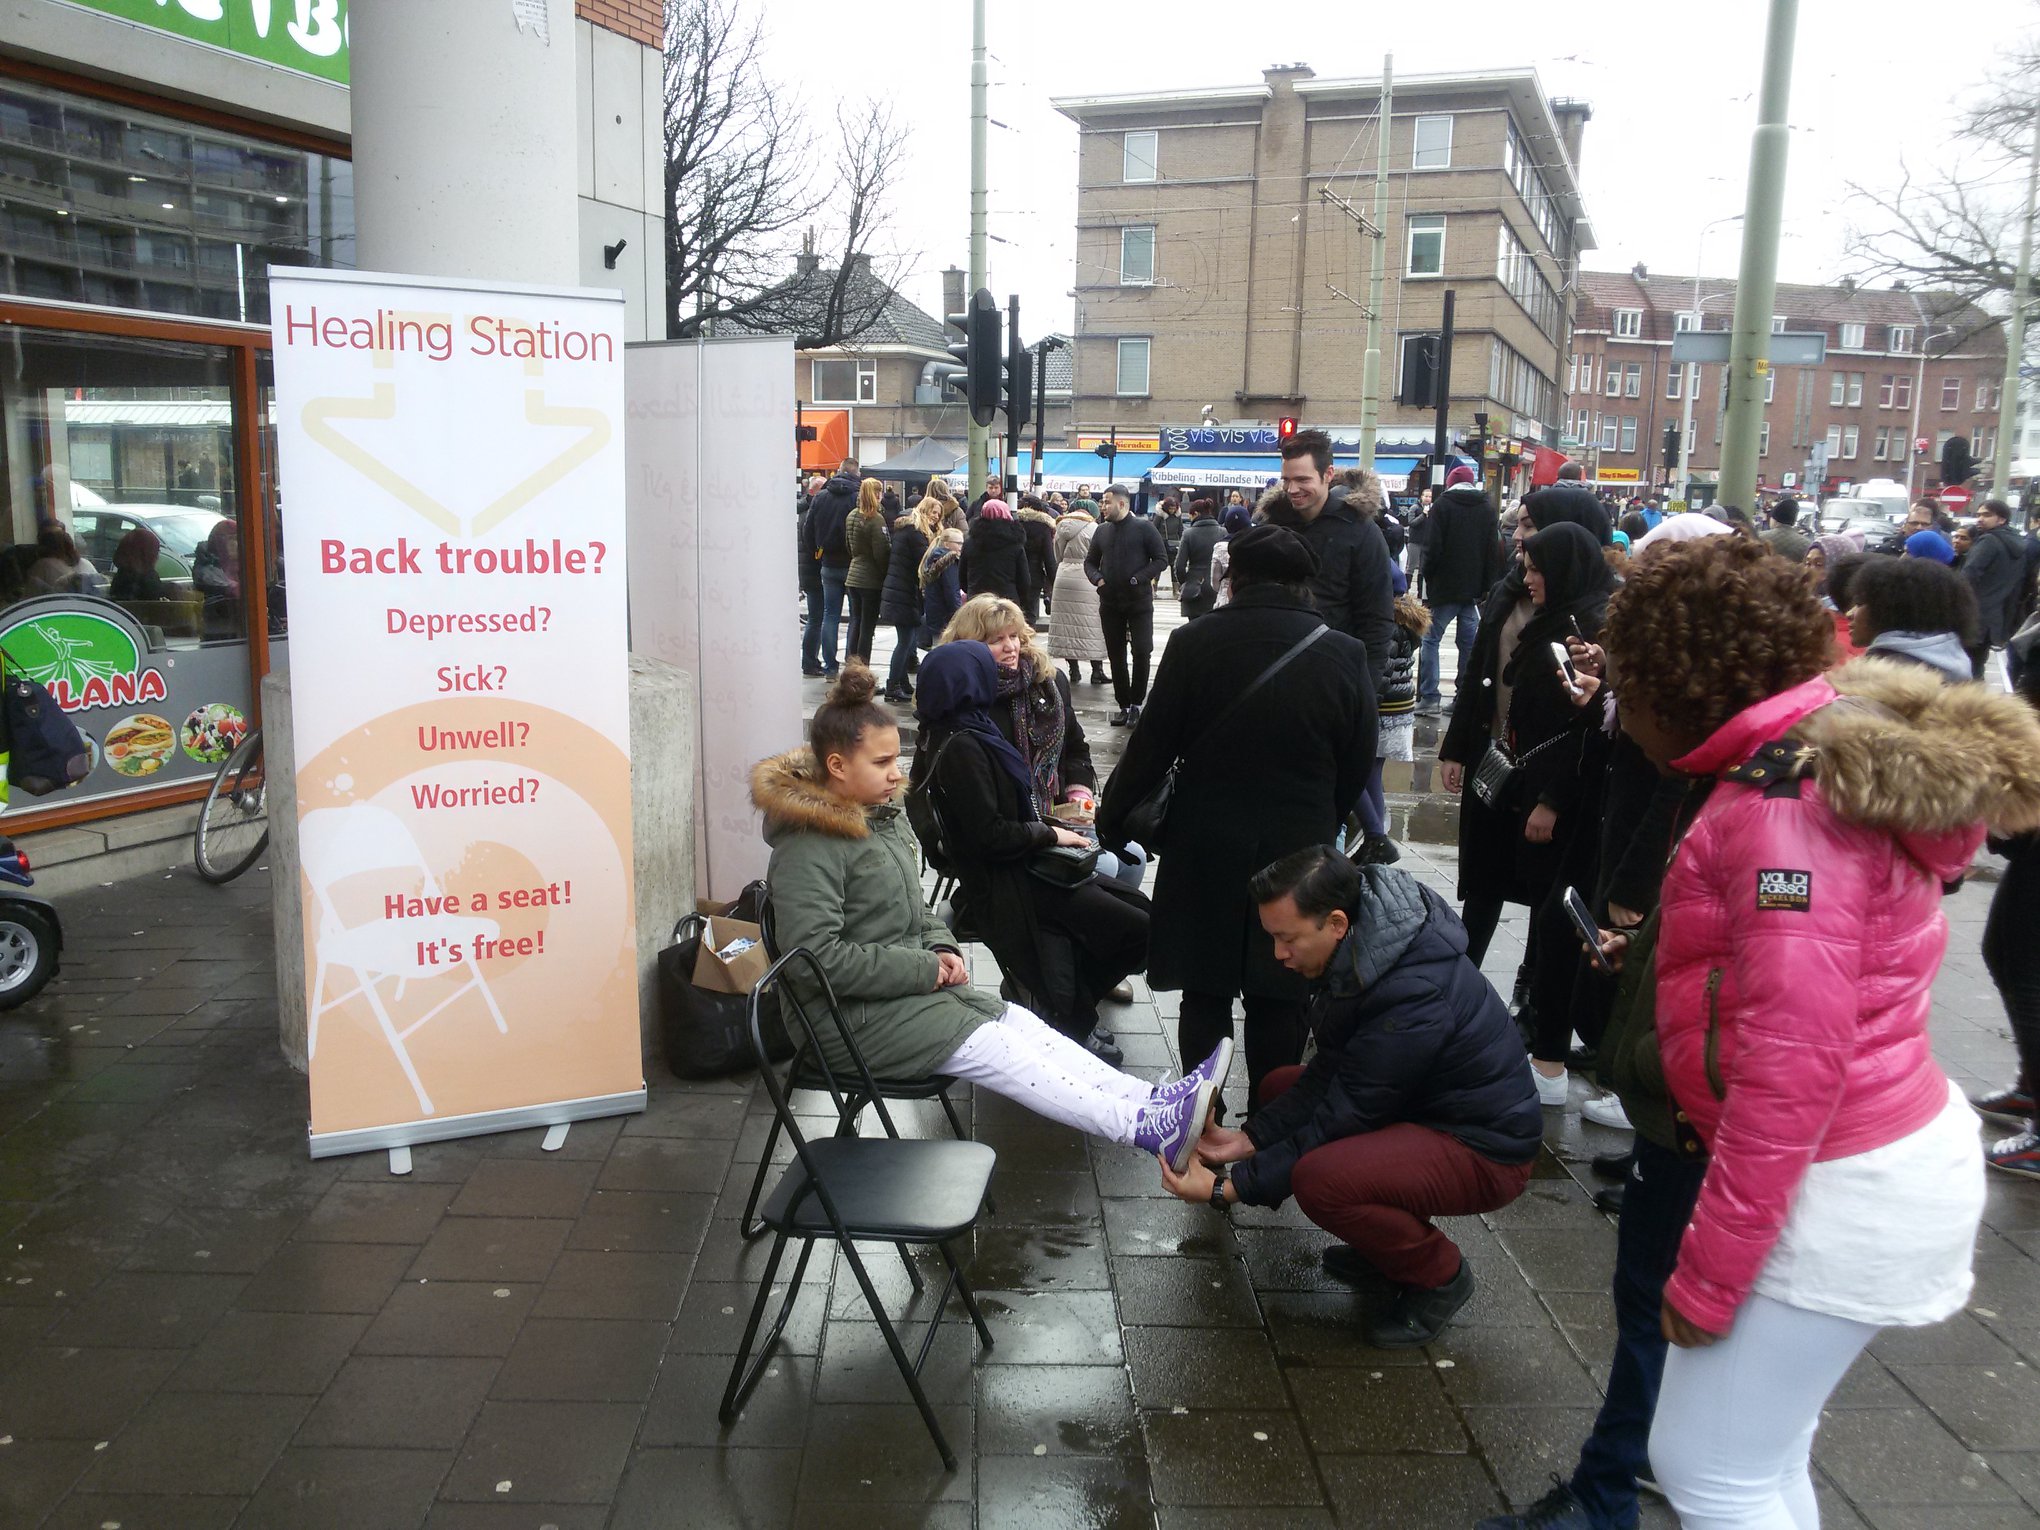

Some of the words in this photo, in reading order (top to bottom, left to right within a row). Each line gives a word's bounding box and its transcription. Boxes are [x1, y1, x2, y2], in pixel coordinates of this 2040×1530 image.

[286, 305, 452, 361] Healing
[470, 315, 613, 362] Station
[1190, 430, 1215, 443] VIS
[1220, 430, 1245, 443] VIS
[1046, 480, 1067, 490] der
[1069, 480, 1101, 491] Torn
[1152, 472, 1196, 484] Kibbeling
[1205, 473, 1252, 484] Hollandse
[320, 538, 422, 574] Back
[436, 539, 607, 574] trouble?
[387, 606, 552, 641] Depressed?
[437, 664, 508, 692] Sick?
[418, 721, 531, 751] Unwell?
[411, 778, 541, 809] Worried?
[385, 893, 461, 919] Have
[470, 892, 488, 912] a
[498, 880, 572, 910] seat!
[417, 938, 463, 966] It's
[472, 930, 544, 960] free!
